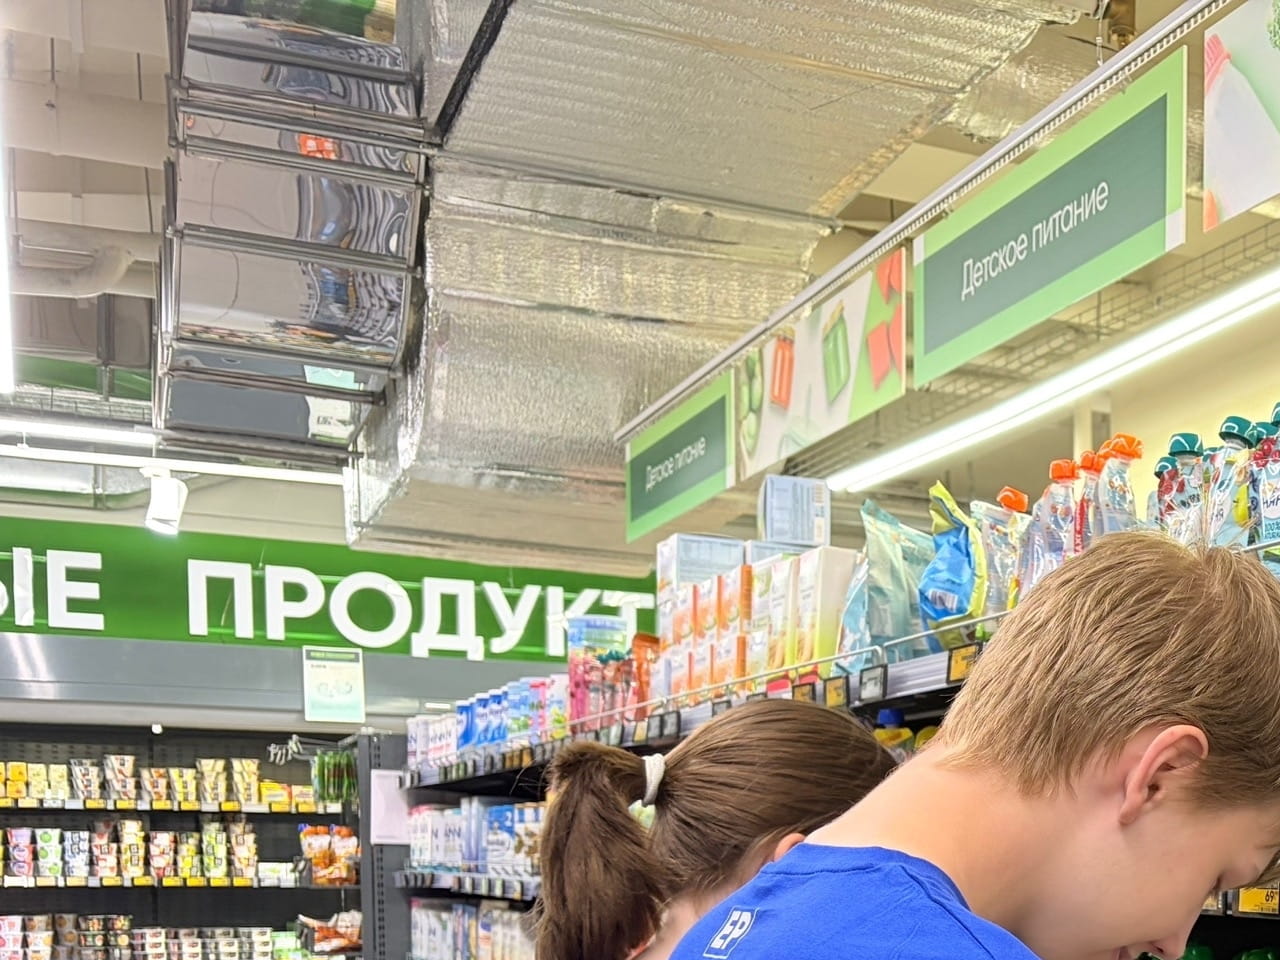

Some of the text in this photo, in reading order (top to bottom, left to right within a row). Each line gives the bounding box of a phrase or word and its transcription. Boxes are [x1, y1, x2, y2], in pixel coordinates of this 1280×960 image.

[961, 180, 1109, 302] Детское питание
[645, 456, 676, 493] Детское
